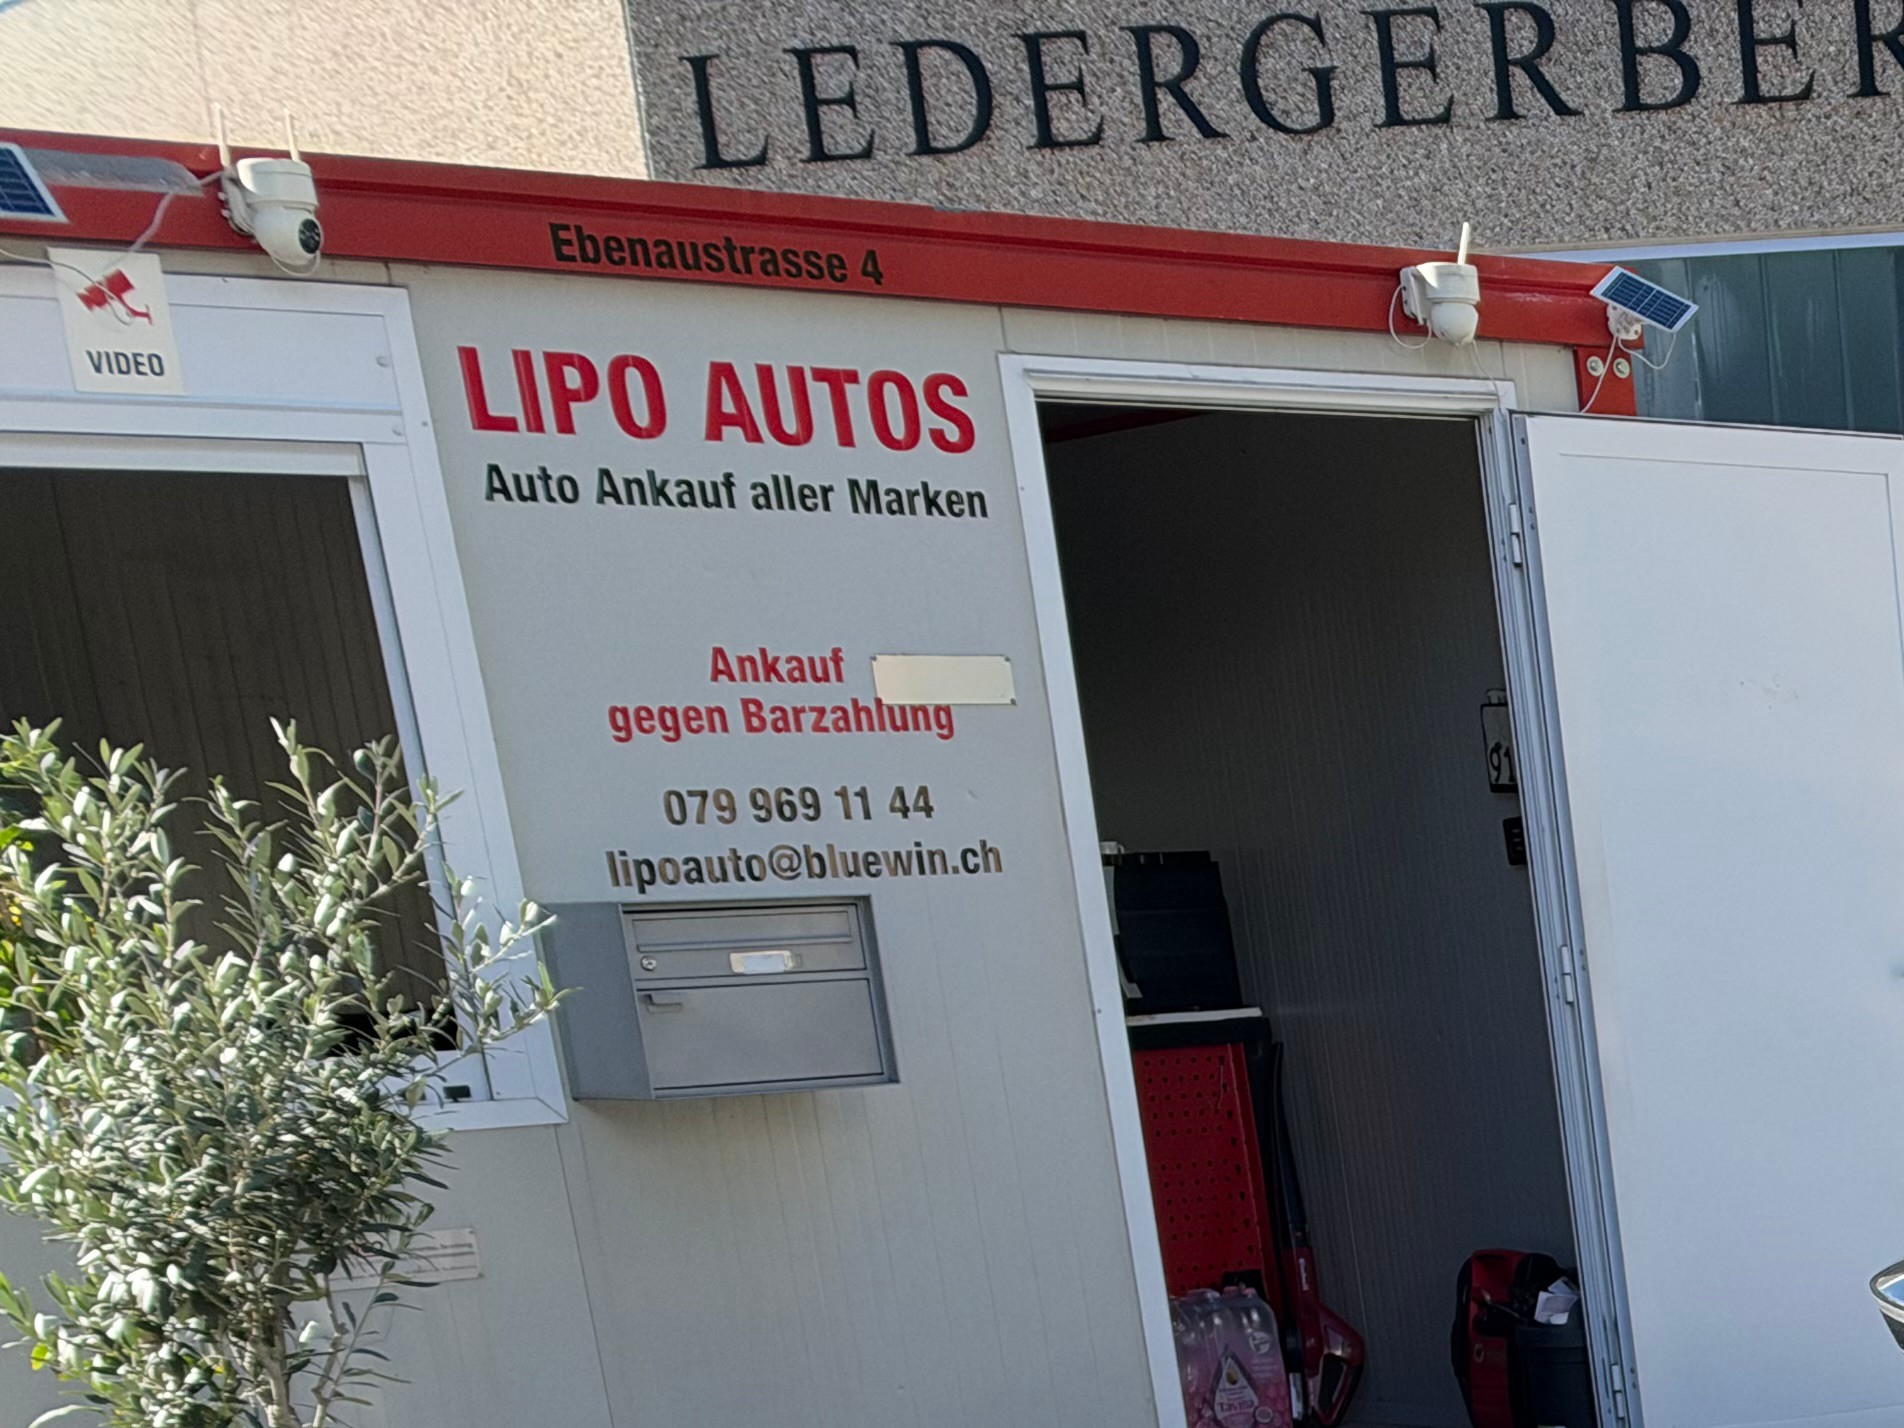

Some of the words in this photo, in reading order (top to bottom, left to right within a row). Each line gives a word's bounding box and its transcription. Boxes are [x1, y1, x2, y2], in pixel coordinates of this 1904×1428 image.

[549, 222, 848, 283] Ebenaustrasse
[861, 250, 884, 285] 4
[86, 350, 165, 377] VIDEO
[457, 345, 668, 440] LIPO
[704, 360, 976, 454] AUTOS
[484, 463, 580, 504] Auto
[596, 467, 737, 510] Ankauf
[749, 474, 836, 513] aller
[847, 479, 990, 519] Marken
[709, 646, 846, 684] Ankauf
[607, 704, 730, 744] gegen
[739, 697, 955, 741] Barzahlung
[663, 788, 738, 827] 079
[749, 786, 822, 823] 969
[834, 786, 873, 821] 11
[889, 785, 935, 820] 44
[605, 839, 1004, 896] lipoauto@bluewin.ch
